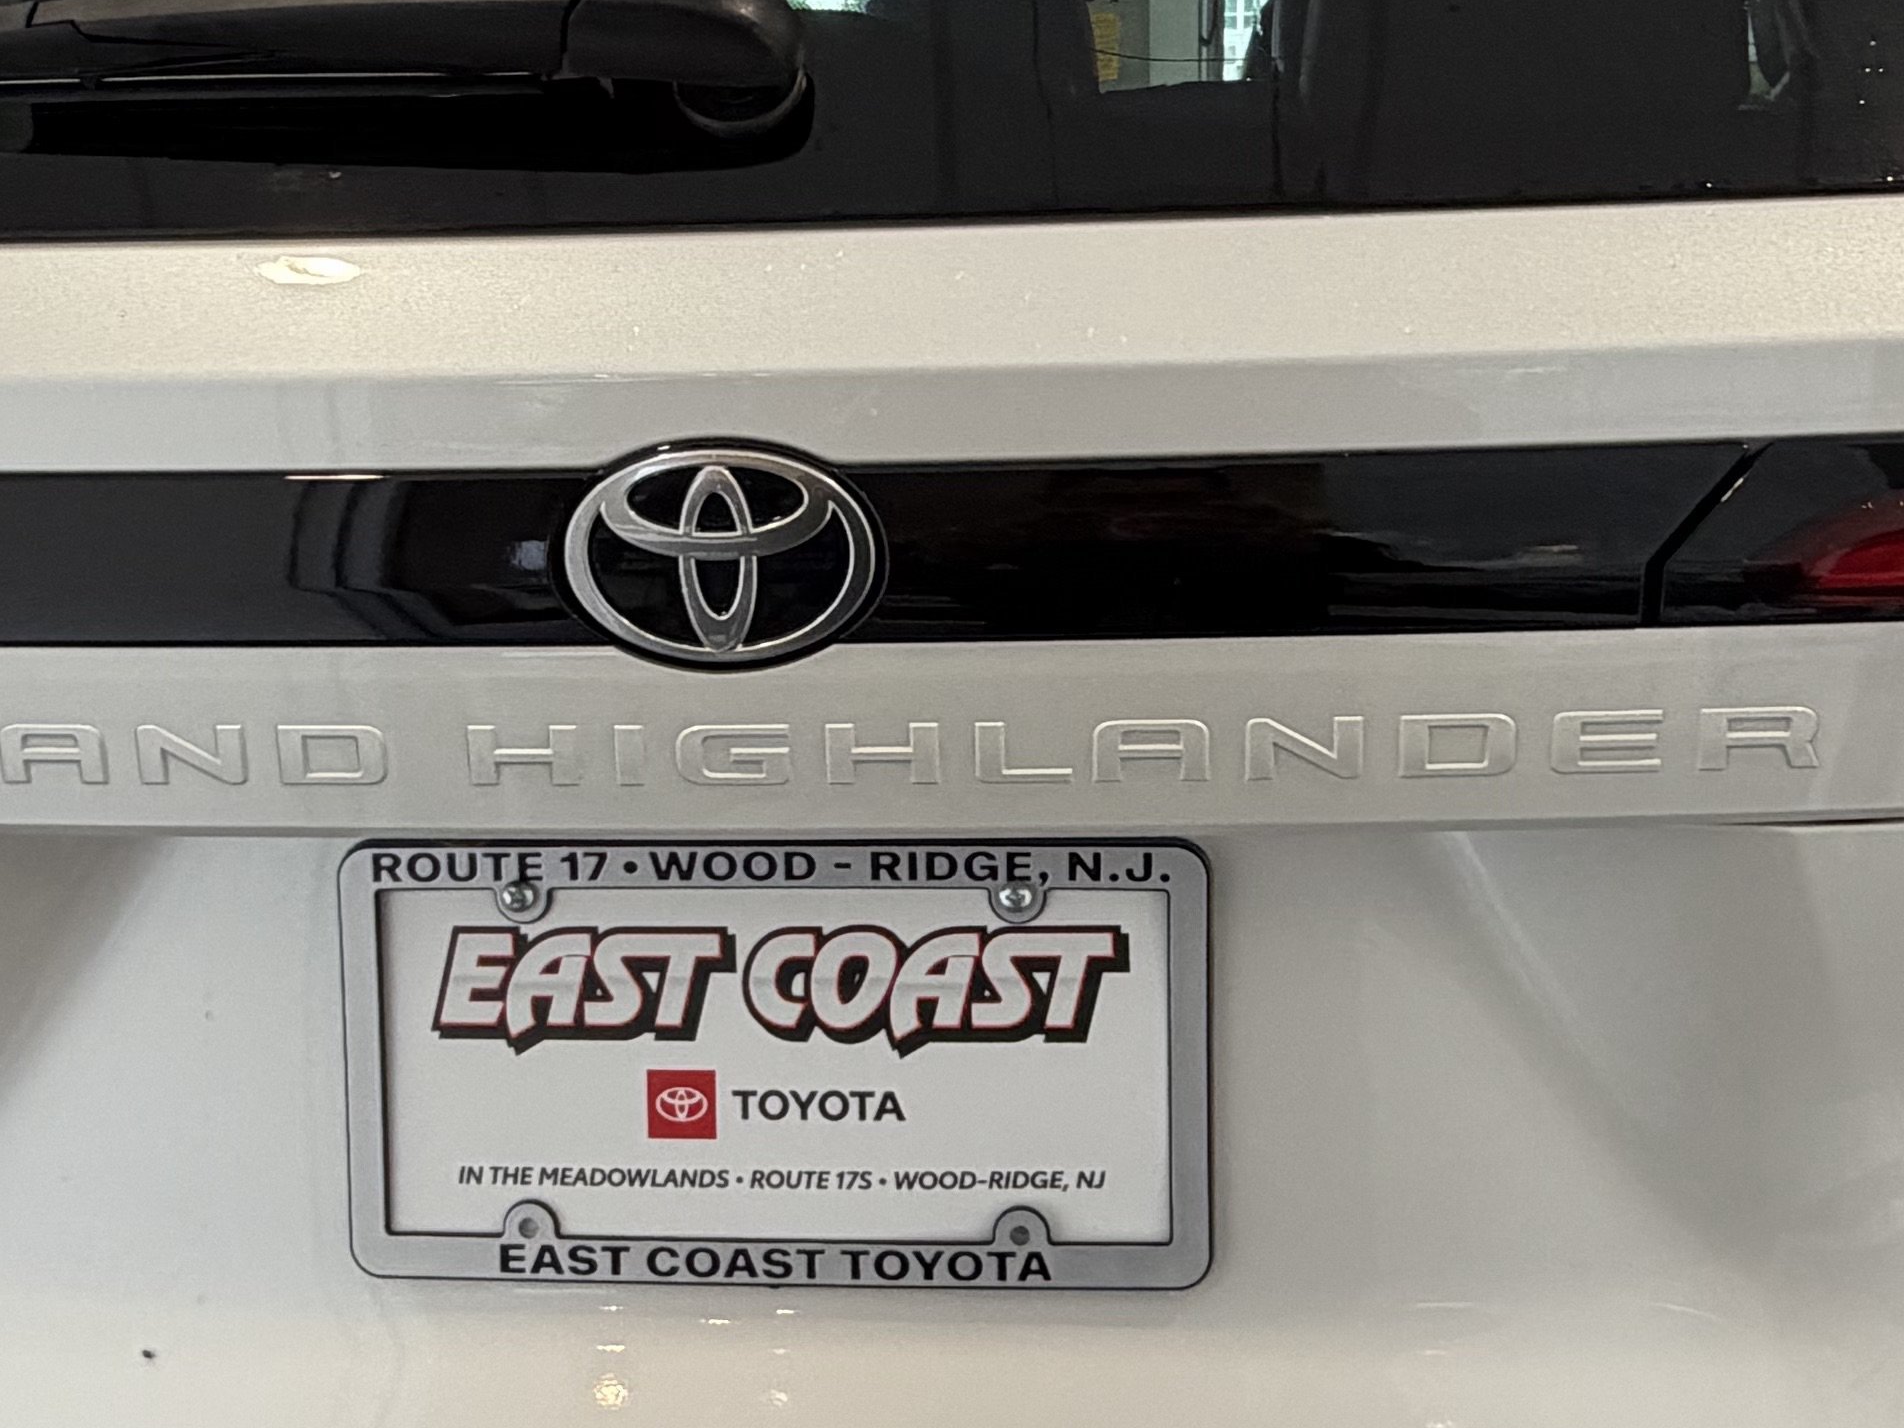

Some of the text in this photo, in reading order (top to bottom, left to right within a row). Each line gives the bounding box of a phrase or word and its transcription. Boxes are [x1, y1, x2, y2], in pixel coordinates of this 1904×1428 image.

[465, 706, 1820, 786] HIGHLANDER
[372, 852, 544, 883] ROUTE
[560, 852, 608, 882] 17
[649, 851, 816, 882] WOOD
[870, 851, 1049, 887] RIDGE,
[1067, 852, 1171, 883] N.J.
[432, 924, 1131, 1059] EAST COAST
[732, 1089, 907, 1122] TOYOTA
[458, 1166, 1107, 1193] IN THE MEADOWLANDS ROUTE 17S WOOD-RIDGE, NJ
[499, 1243, 1052, 1282] EAST COAST TOYOTA
